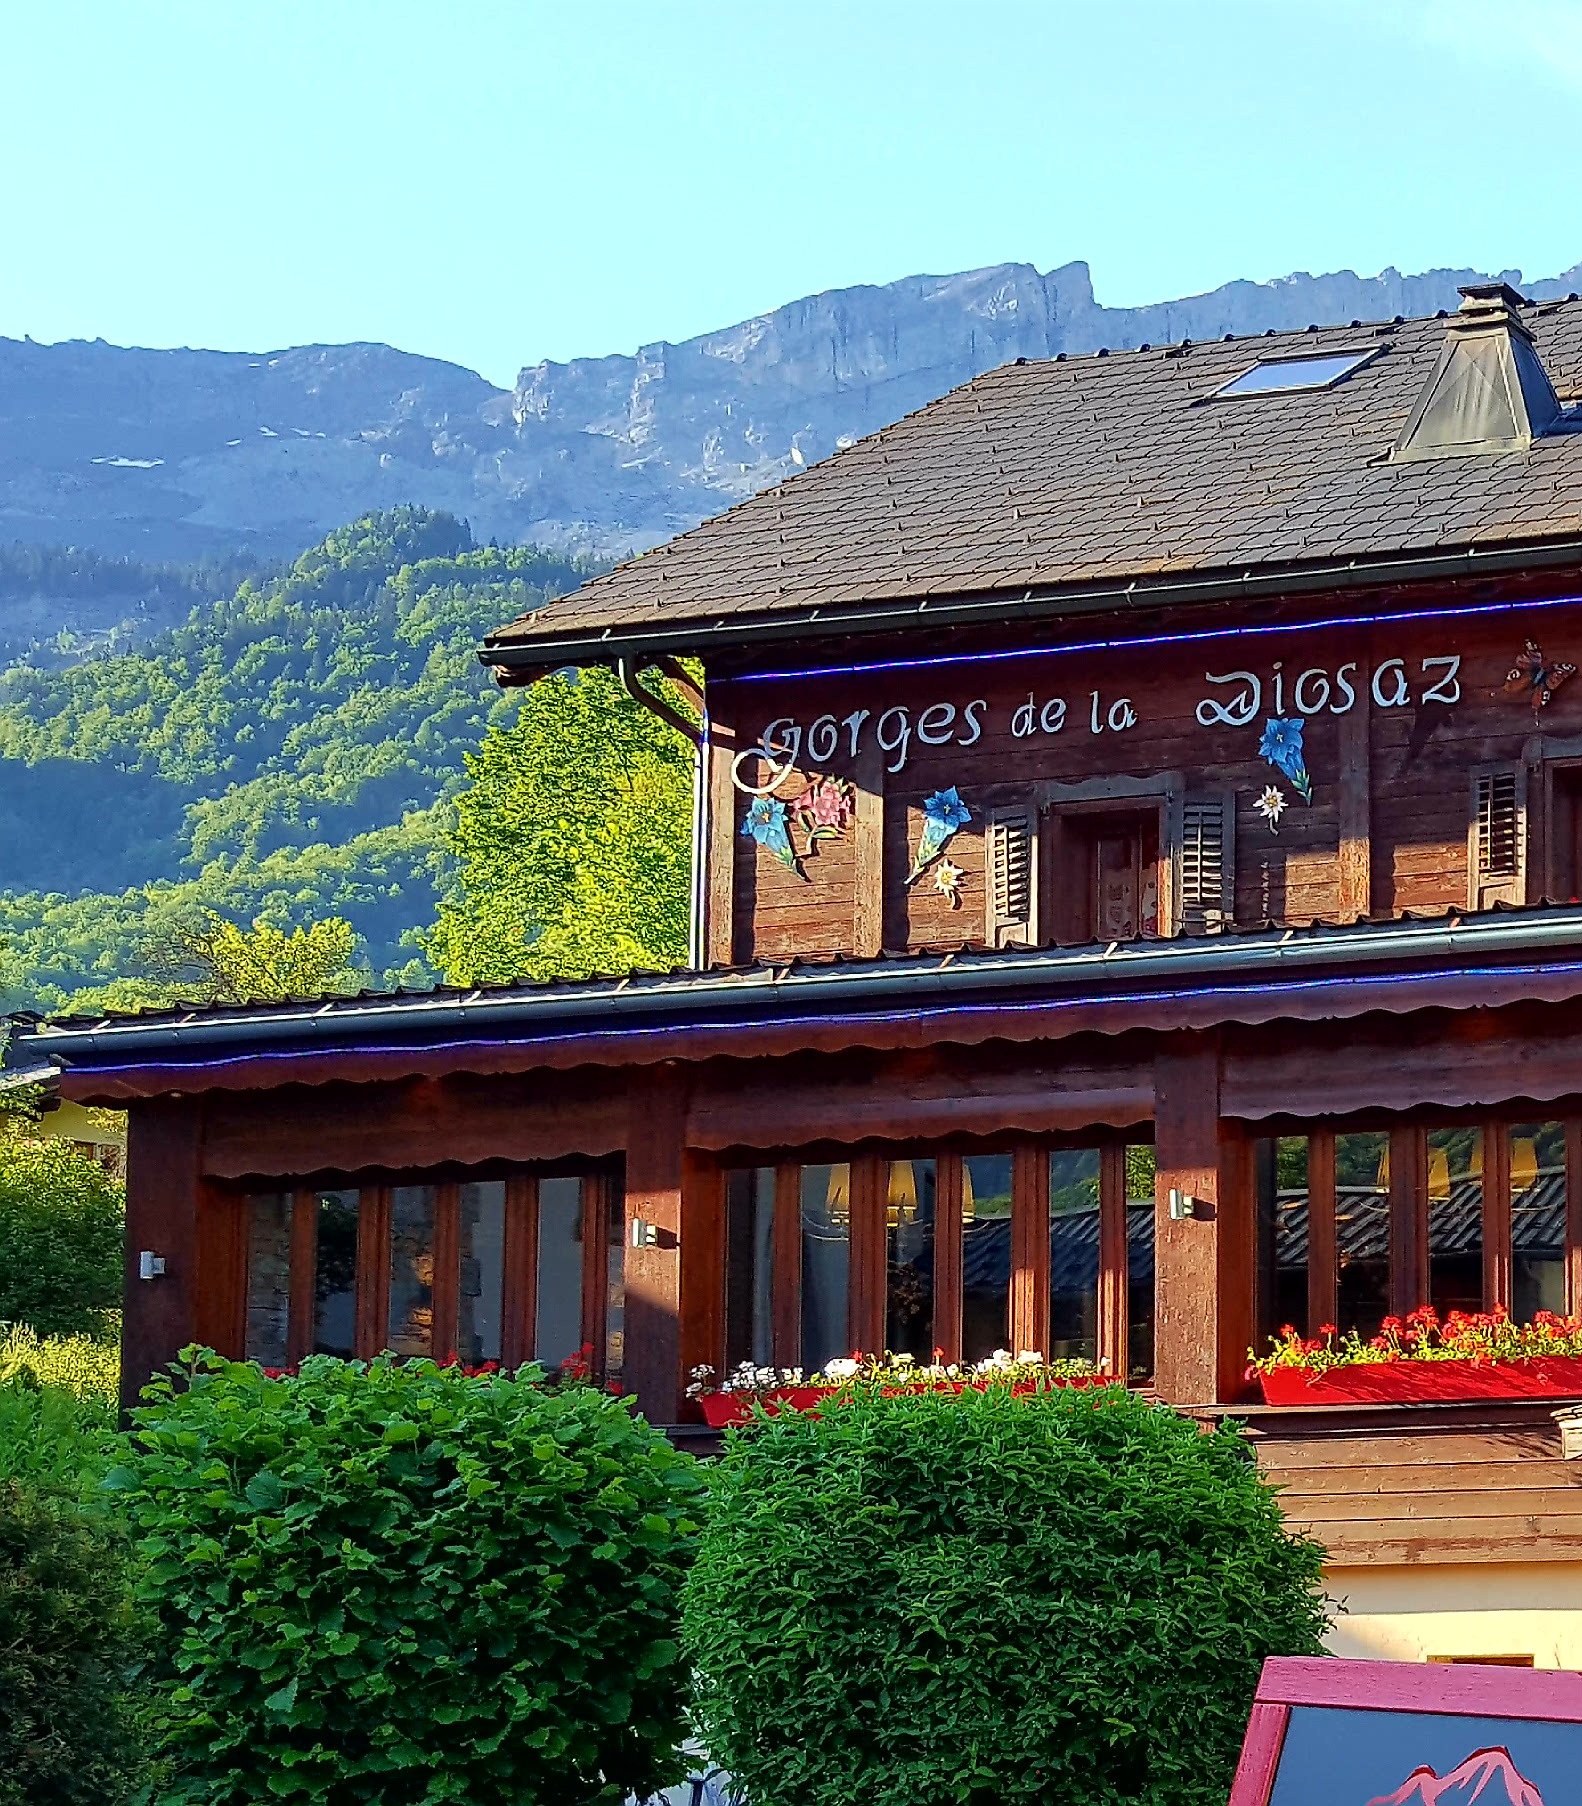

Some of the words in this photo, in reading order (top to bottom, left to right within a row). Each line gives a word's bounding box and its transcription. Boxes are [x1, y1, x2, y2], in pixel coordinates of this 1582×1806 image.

[731, 698, 988, 795] Gorges
[1011, 691, 1065, 738] de
[1089, 690, 1138, 735] la
[1195, 654, 1461, 727] Diosaz
